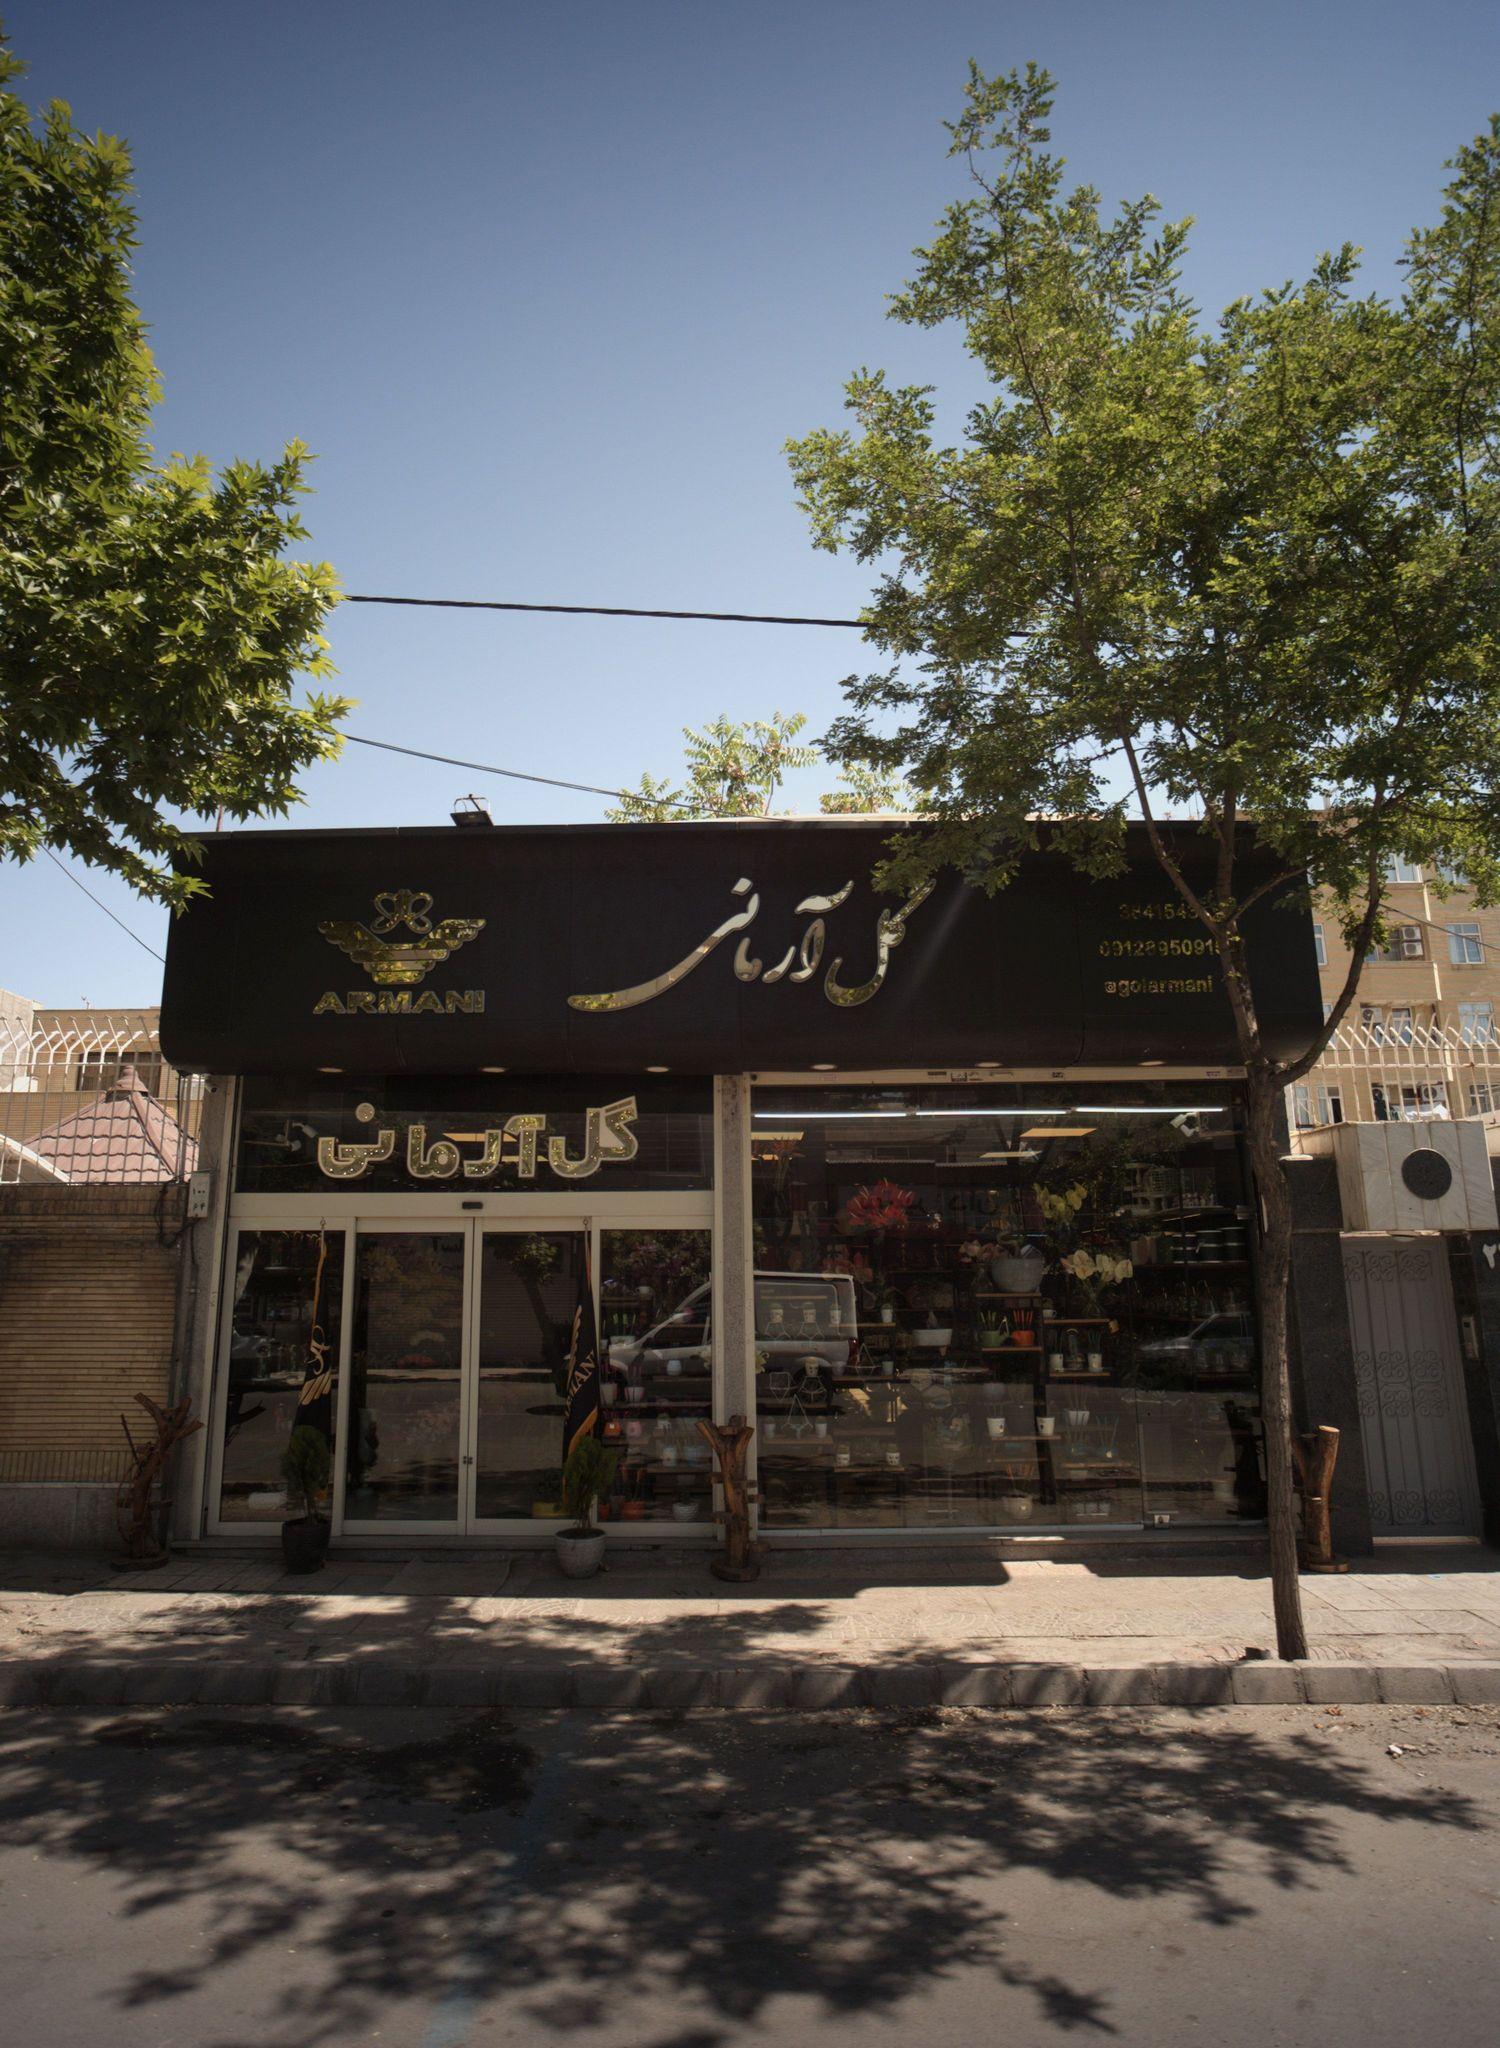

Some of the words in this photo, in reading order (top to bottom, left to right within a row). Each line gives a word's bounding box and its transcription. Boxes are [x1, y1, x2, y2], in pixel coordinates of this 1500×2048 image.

[567, 877, 854, 1012] آرمانی
[824, 878, 937, 1007] گل
[312, 990, 486, 1014] ARMANI
[318, 1102, 546, 1178] آرمانی
[549, 1095, 638, 1178] گل
